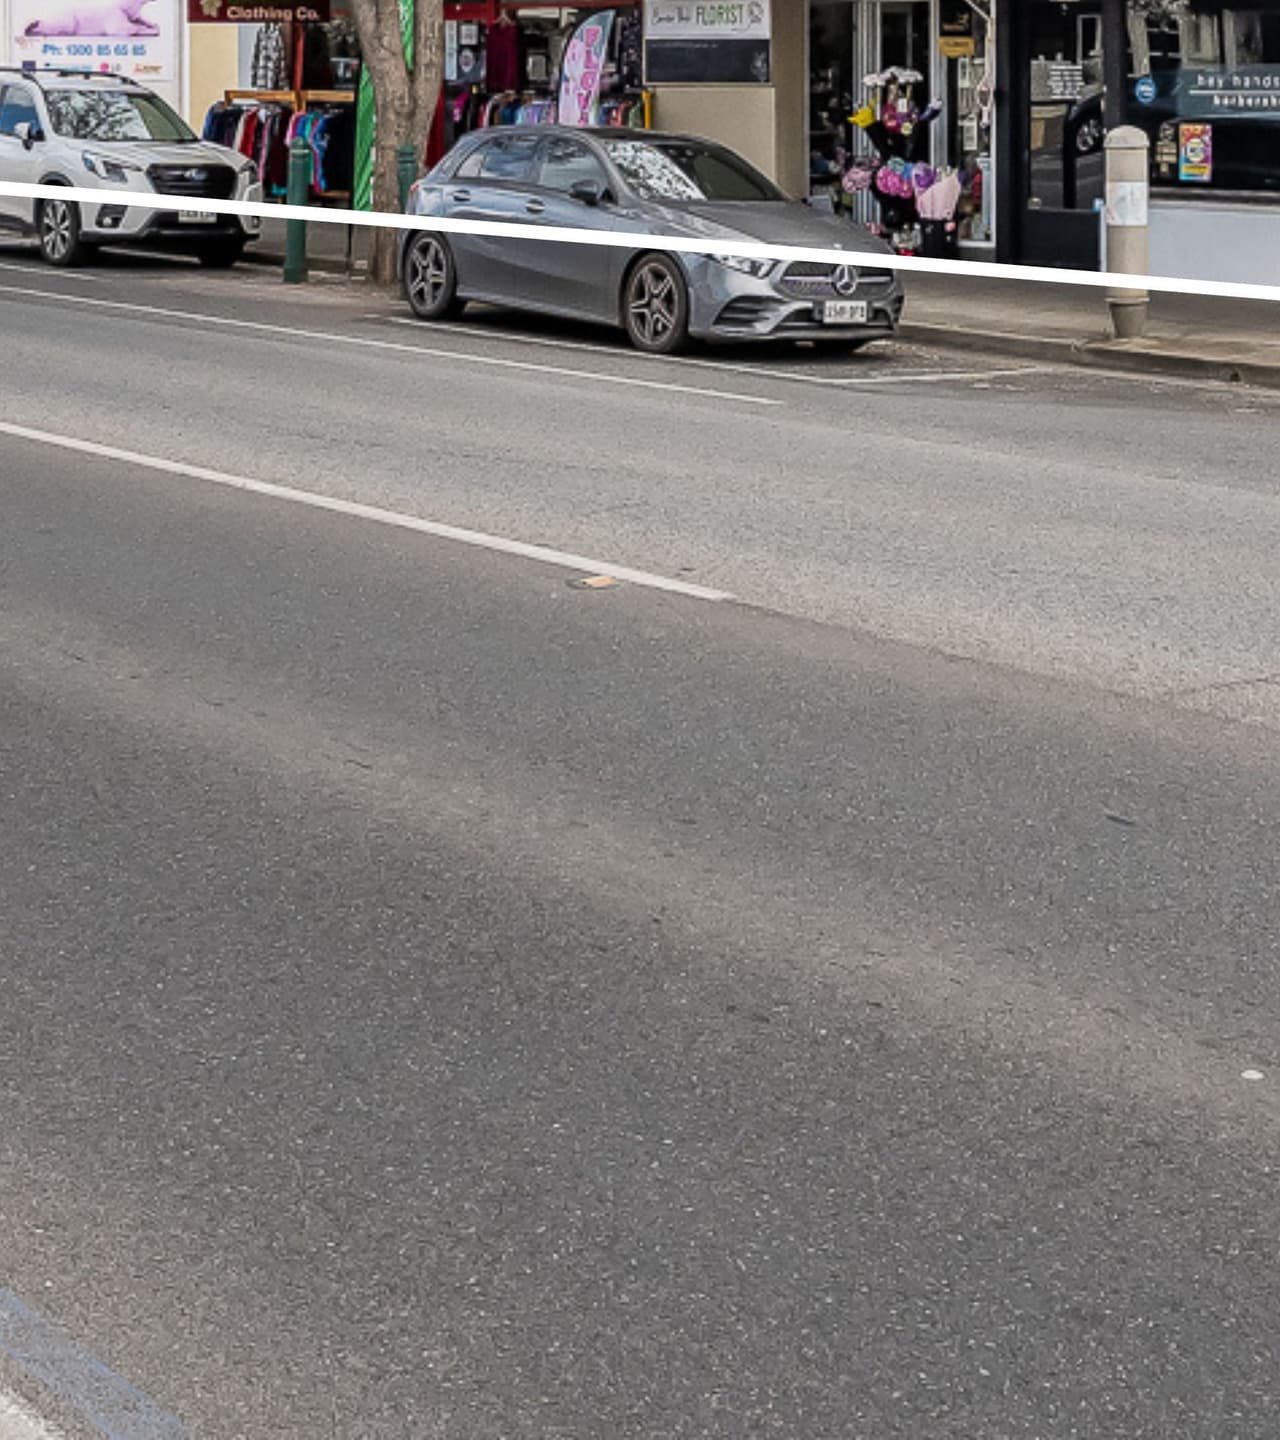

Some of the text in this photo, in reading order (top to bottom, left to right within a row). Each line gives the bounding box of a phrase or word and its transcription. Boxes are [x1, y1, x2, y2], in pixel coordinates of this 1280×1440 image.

[226, 5, 321, 22] Clothing Co.
[696, 4, 744, 27] FLORIST
[1197, 74, 1223, 89] hey
